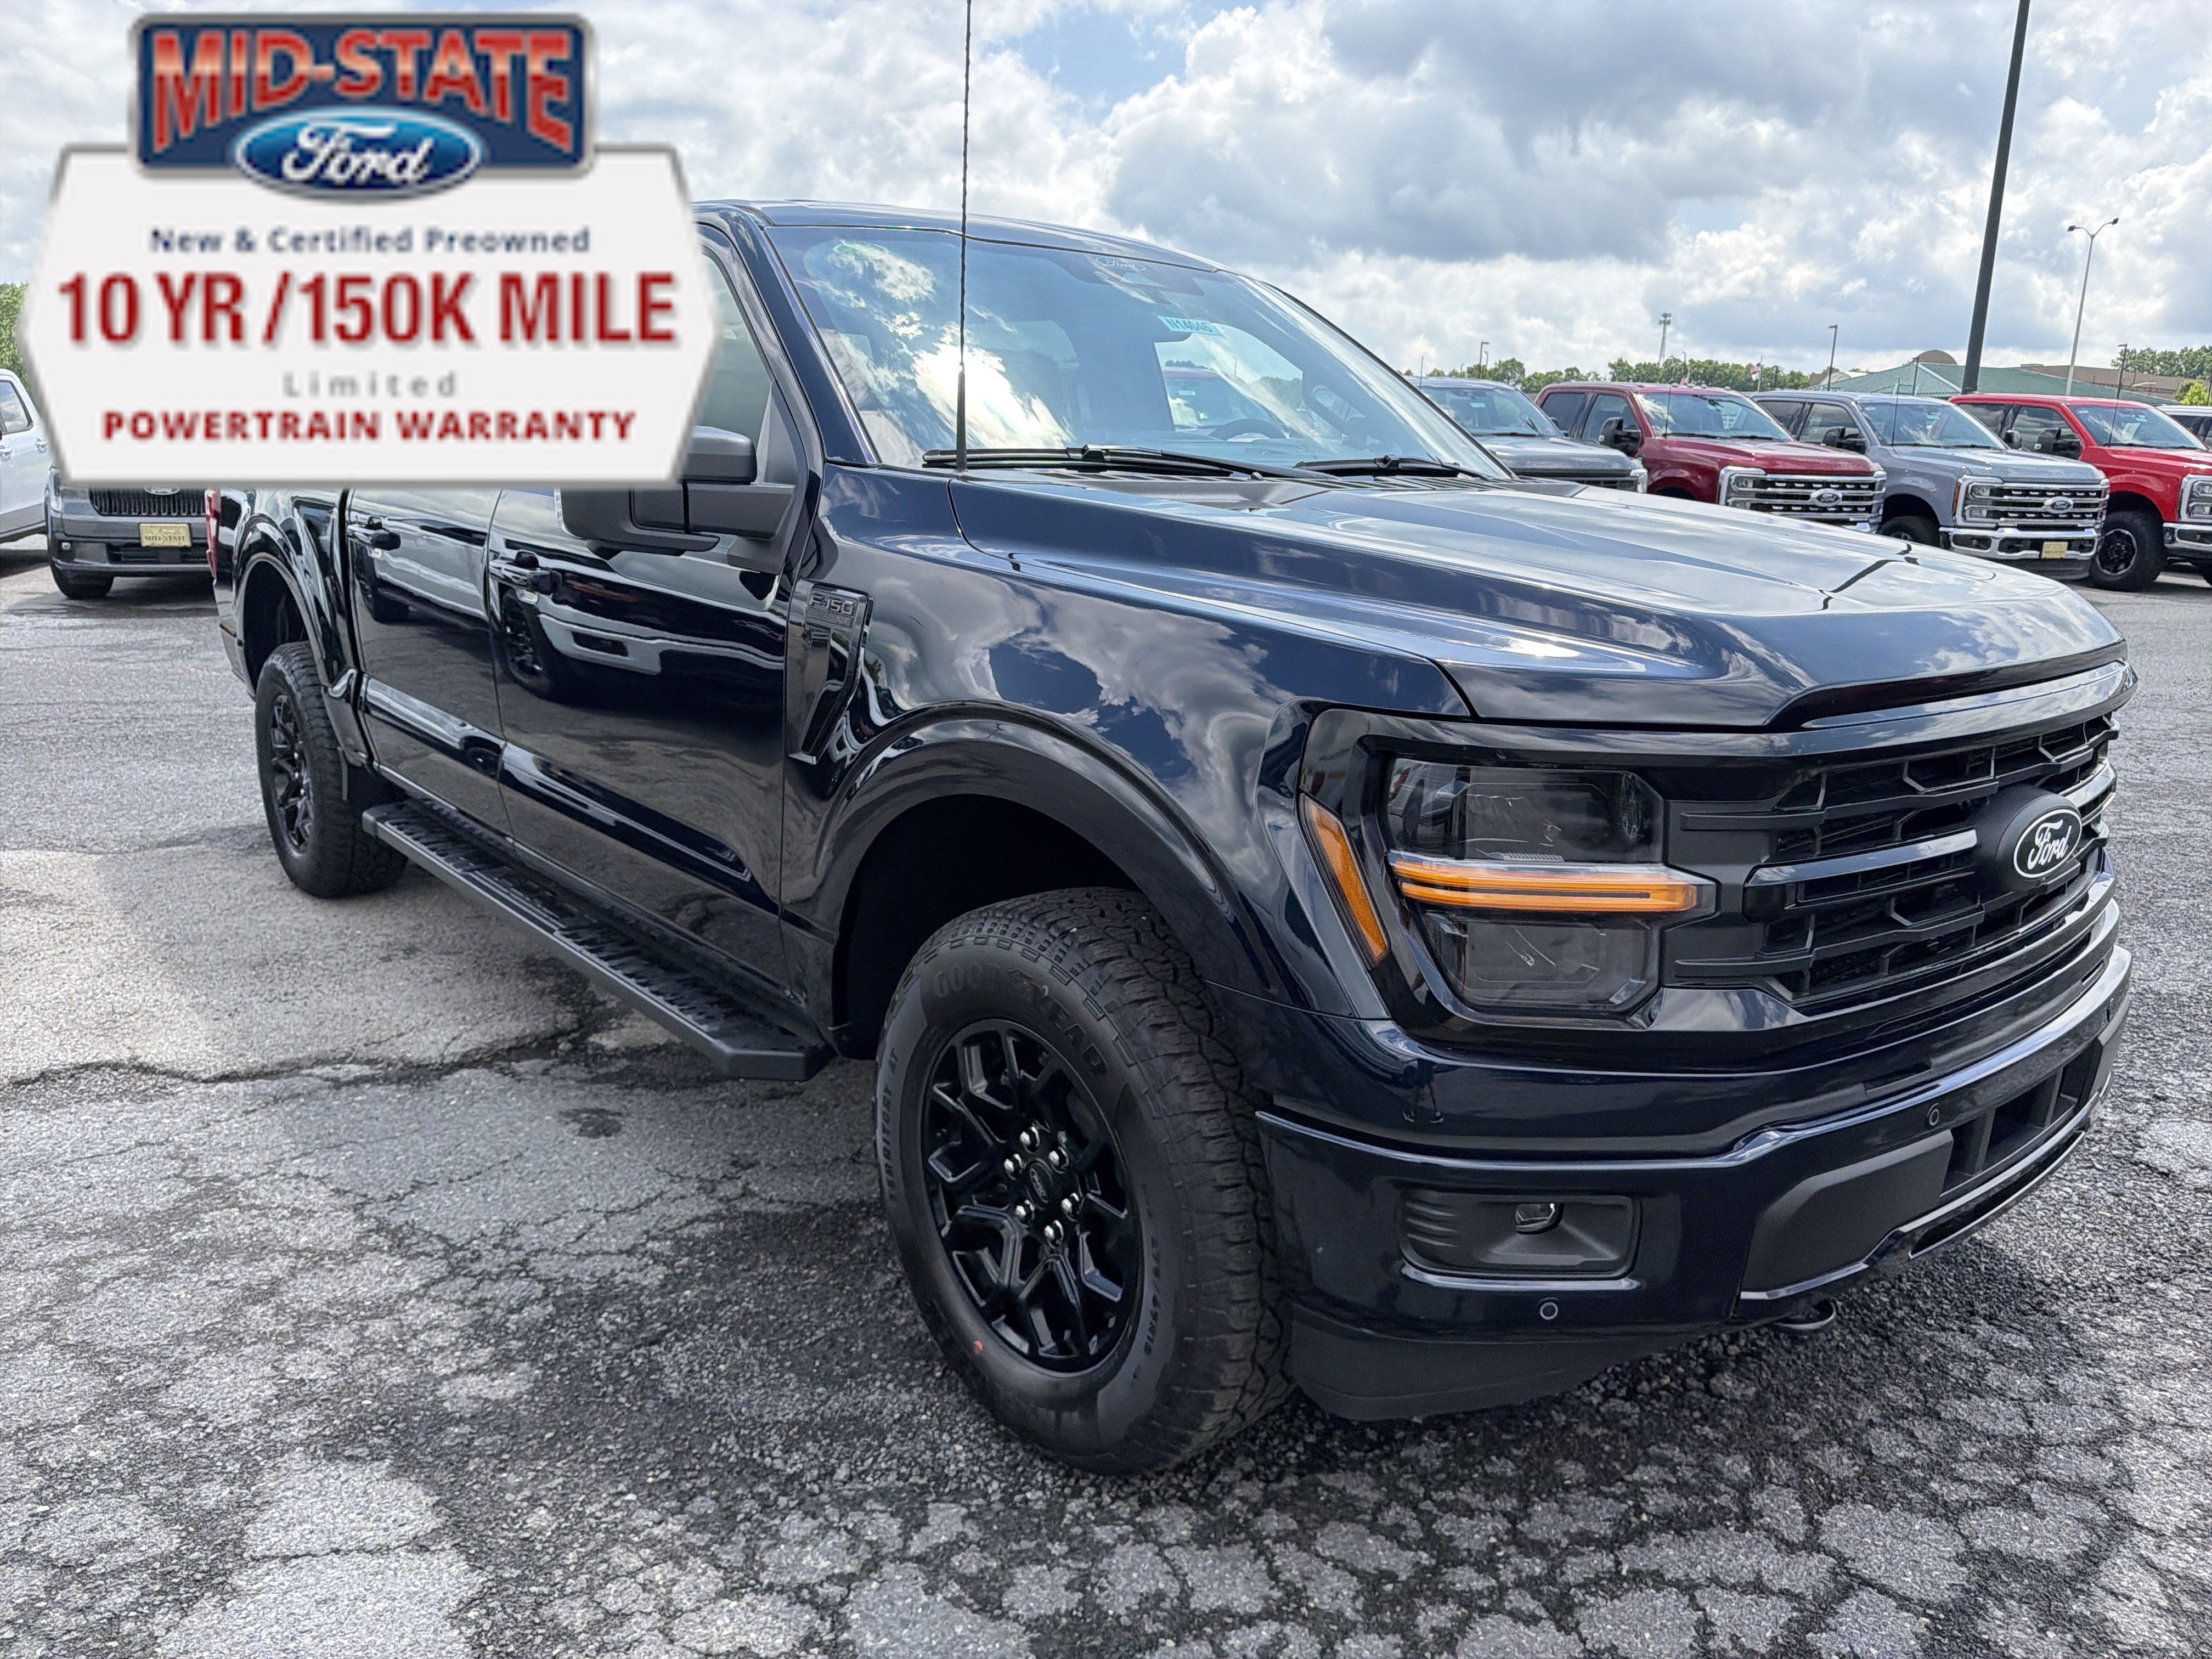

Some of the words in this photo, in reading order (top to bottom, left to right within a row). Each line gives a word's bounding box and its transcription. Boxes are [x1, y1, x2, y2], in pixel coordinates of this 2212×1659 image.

[1820, 493, 1837, 501] Ford
[809, 594, 854, 614] F-150
[2027, 819, 2072, 870] Ford
